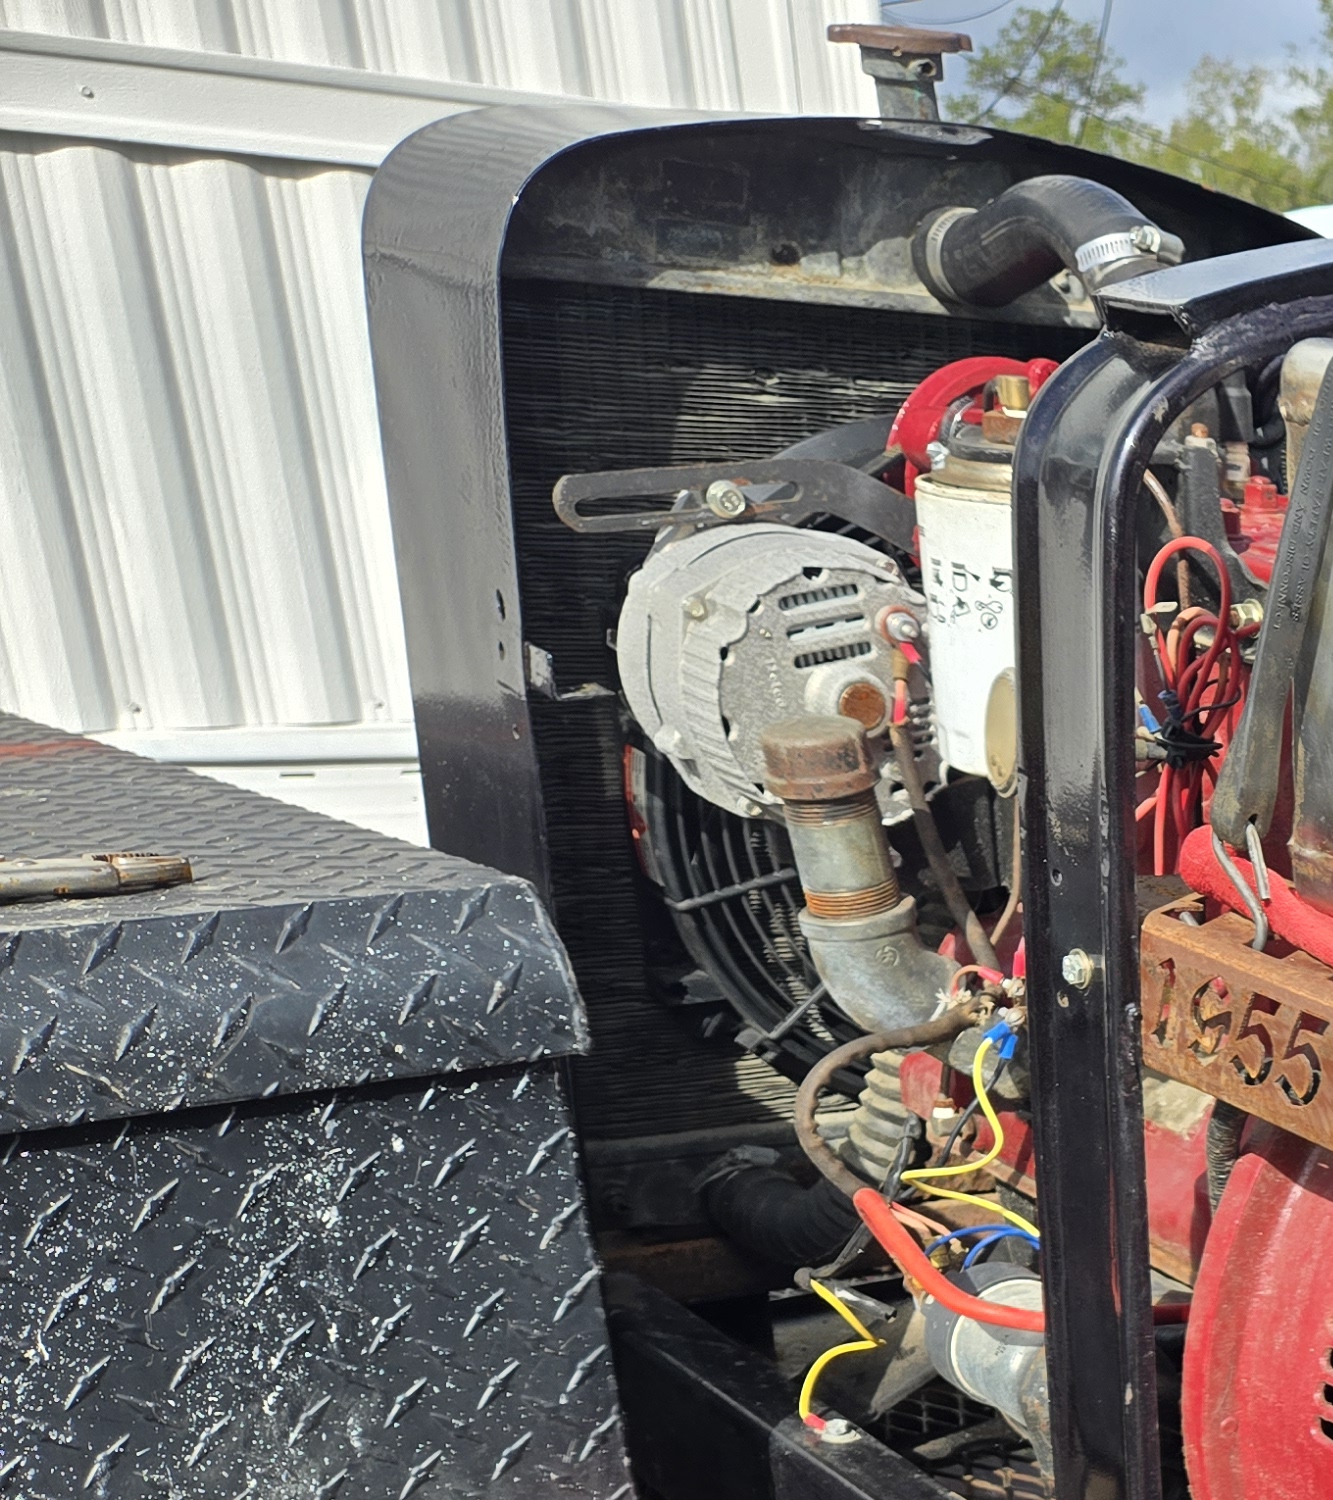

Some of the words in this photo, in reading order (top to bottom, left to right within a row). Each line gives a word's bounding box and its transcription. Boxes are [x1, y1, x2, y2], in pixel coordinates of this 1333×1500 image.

[1300, 449, 1316, 494] DOWN
[1293, 502, 1307, 535] AND
[1273, 538, 1298, 630] DISCONNECT
[1151, 956, 1331, 1107] 1955
